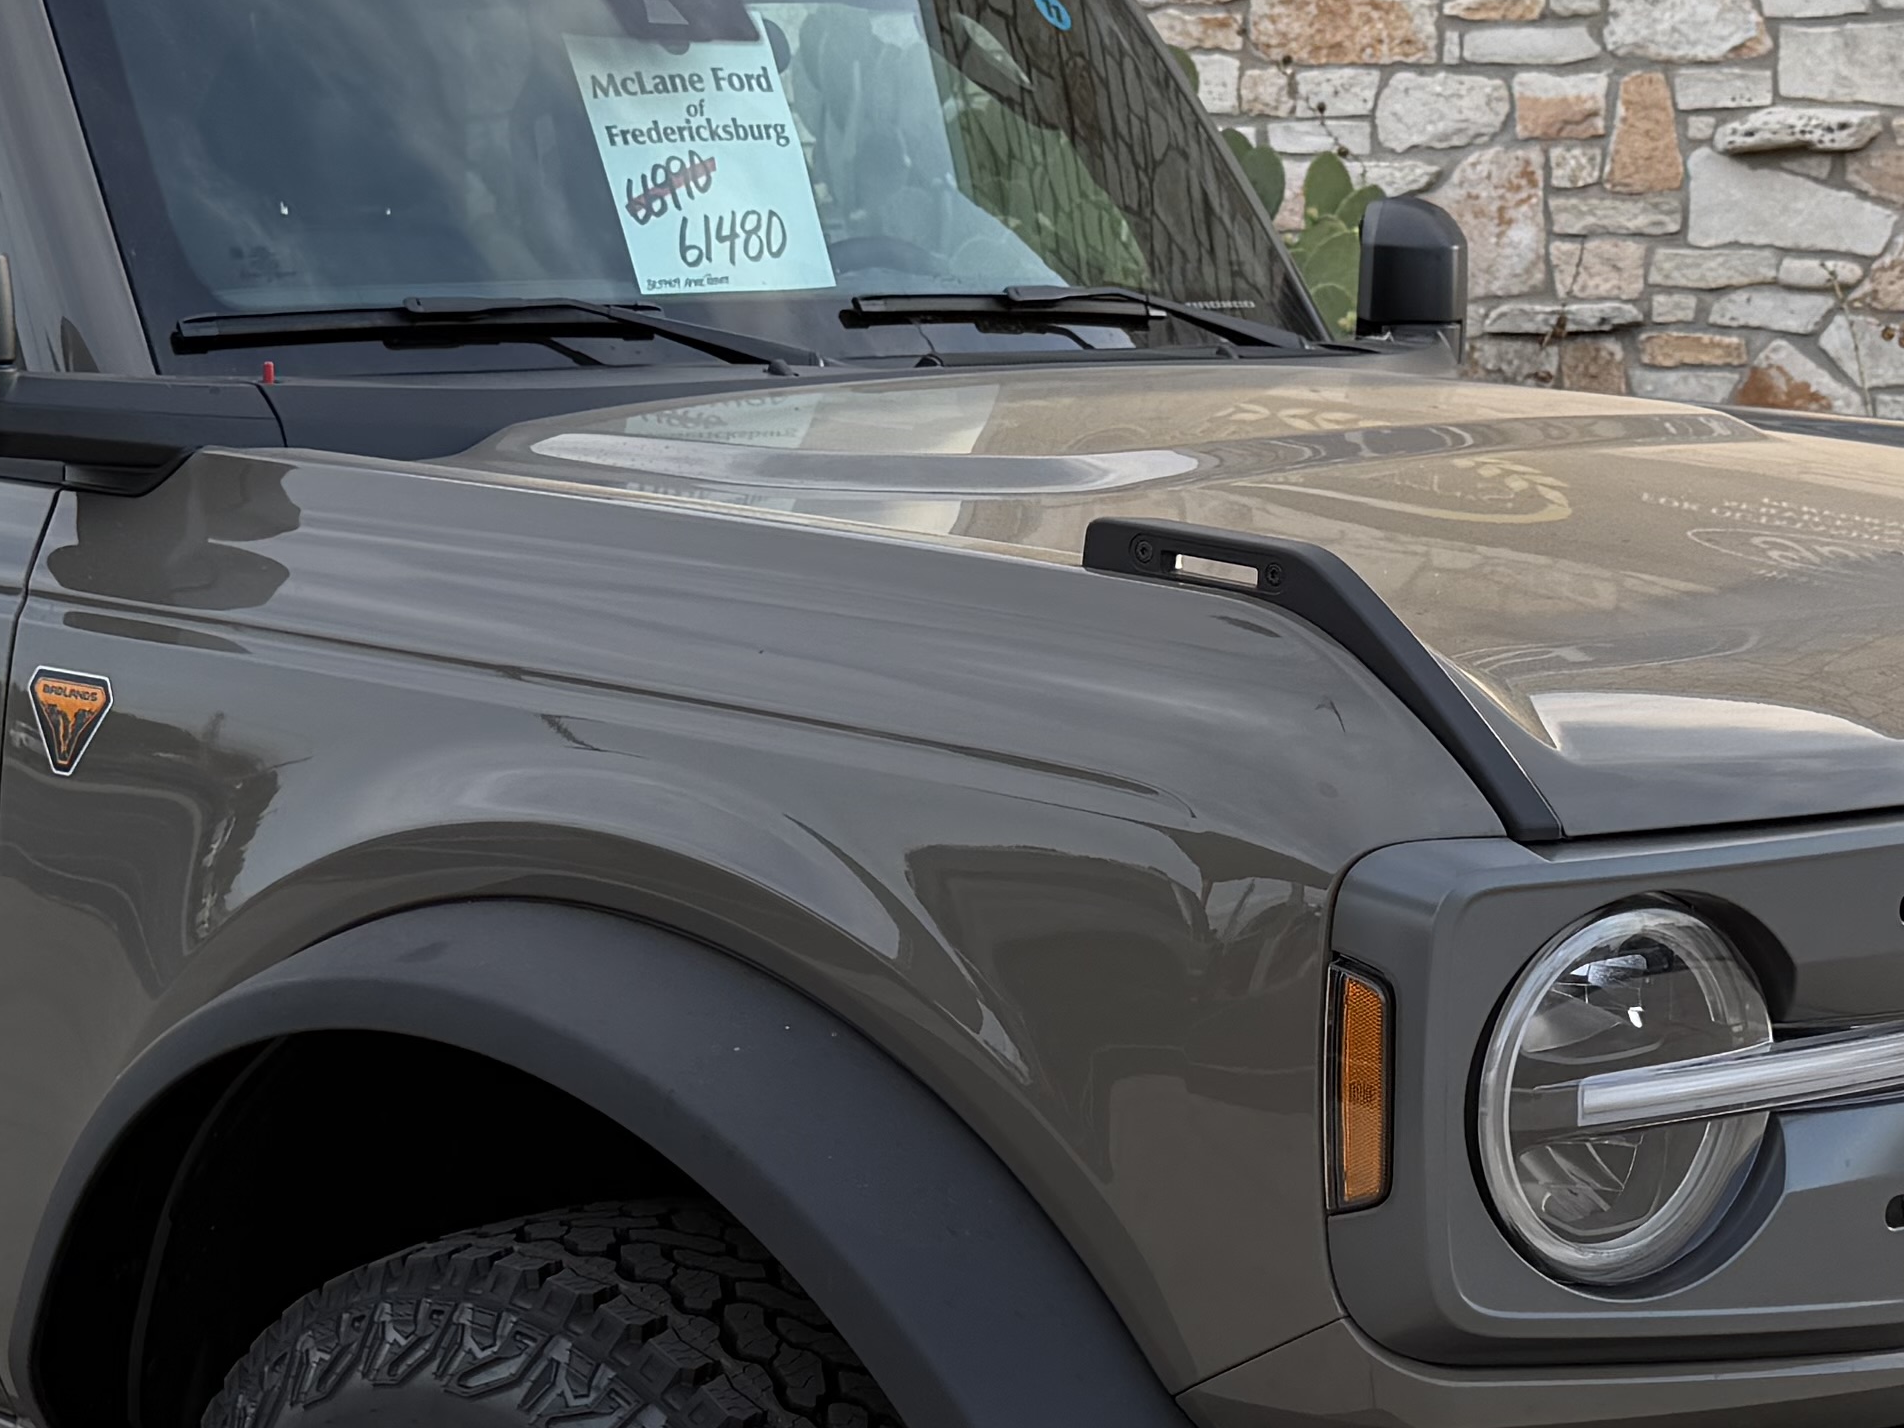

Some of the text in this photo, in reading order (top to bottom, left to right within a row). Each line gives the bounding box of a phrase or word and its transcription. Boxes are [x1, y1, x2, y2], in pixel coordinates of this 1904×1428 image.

[590, 66, 775, 100] McLane Ford
[686, 99, 705, 117] of
[605, 118, 791, 147] Fredericksburg
[679, 209, 788, 267] 61480
[42, 683, 99, 702] BADLANDS
